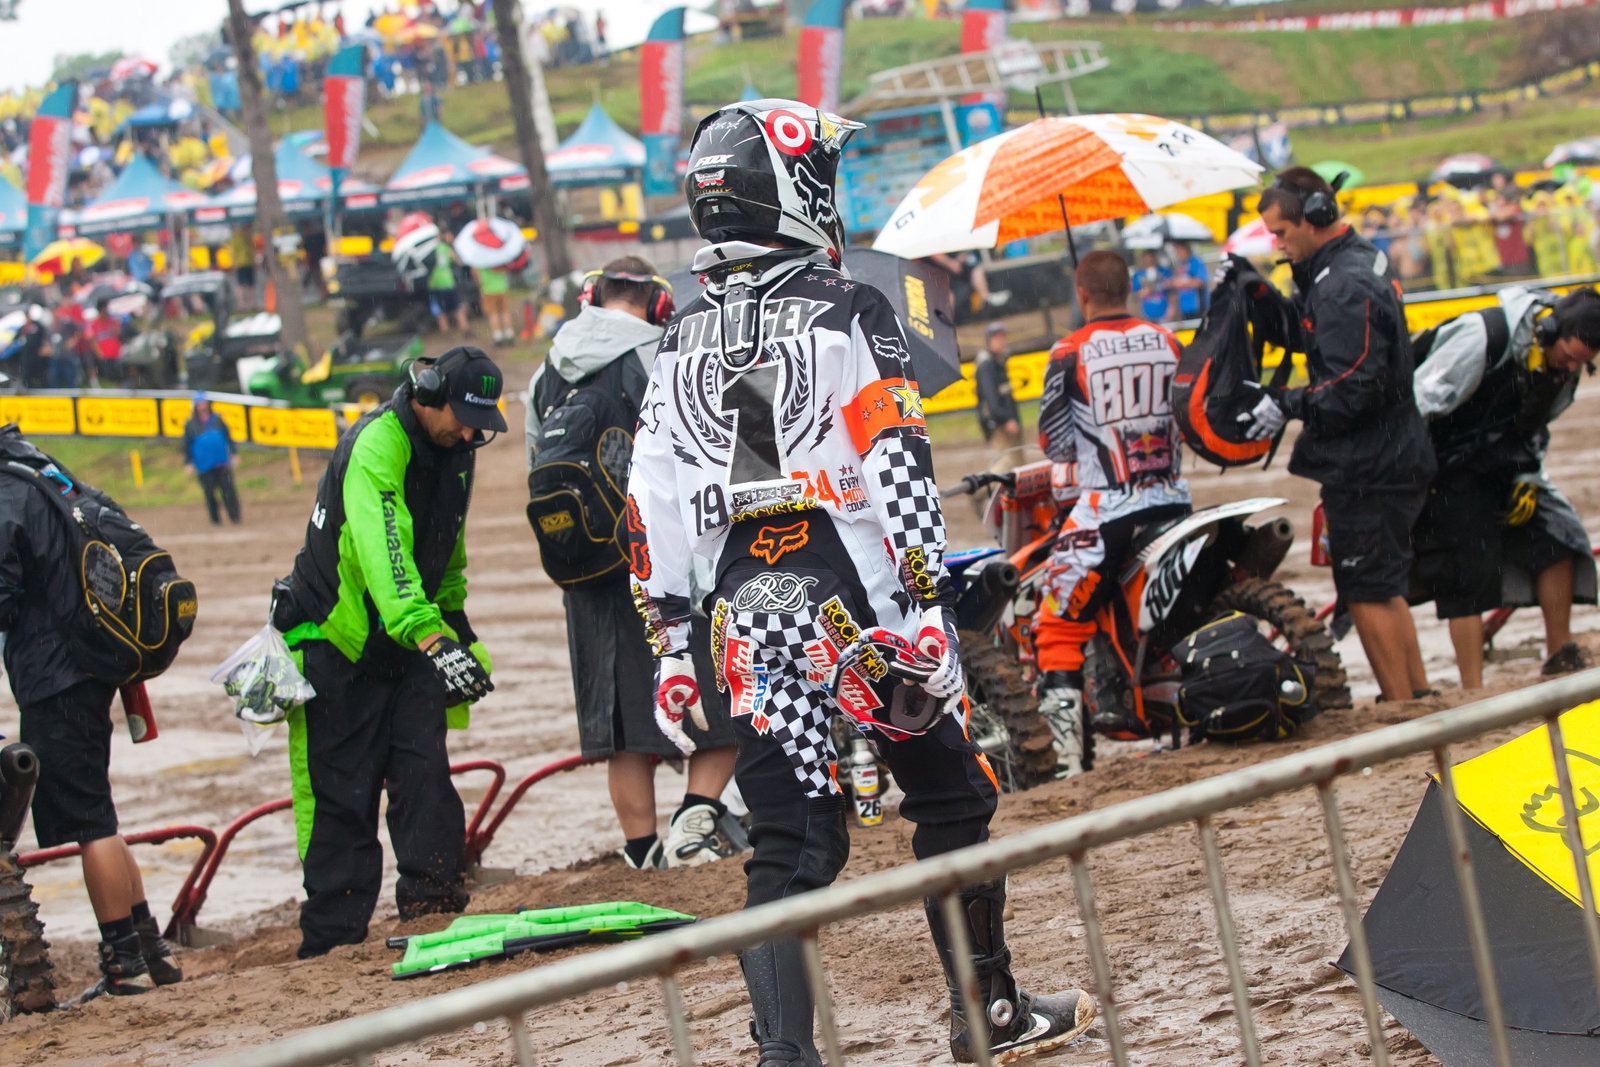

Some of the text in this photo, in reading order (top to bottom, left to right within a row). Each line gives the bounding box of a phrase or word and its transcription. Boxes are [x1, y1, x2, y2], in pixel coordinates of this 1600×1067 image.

[712, 246, 727, 262] 1
[732, 261, 754, 273] GPX
[1082, 332, 1167, 363] ALESSI
[720, 358, 789, 488] 1
[690, 484, 728, 537] 19
[379, 489, 418, 600] Kawasaki
[753, 666, 768, 711] SUZI
[860, 800, 882, 818] 26
